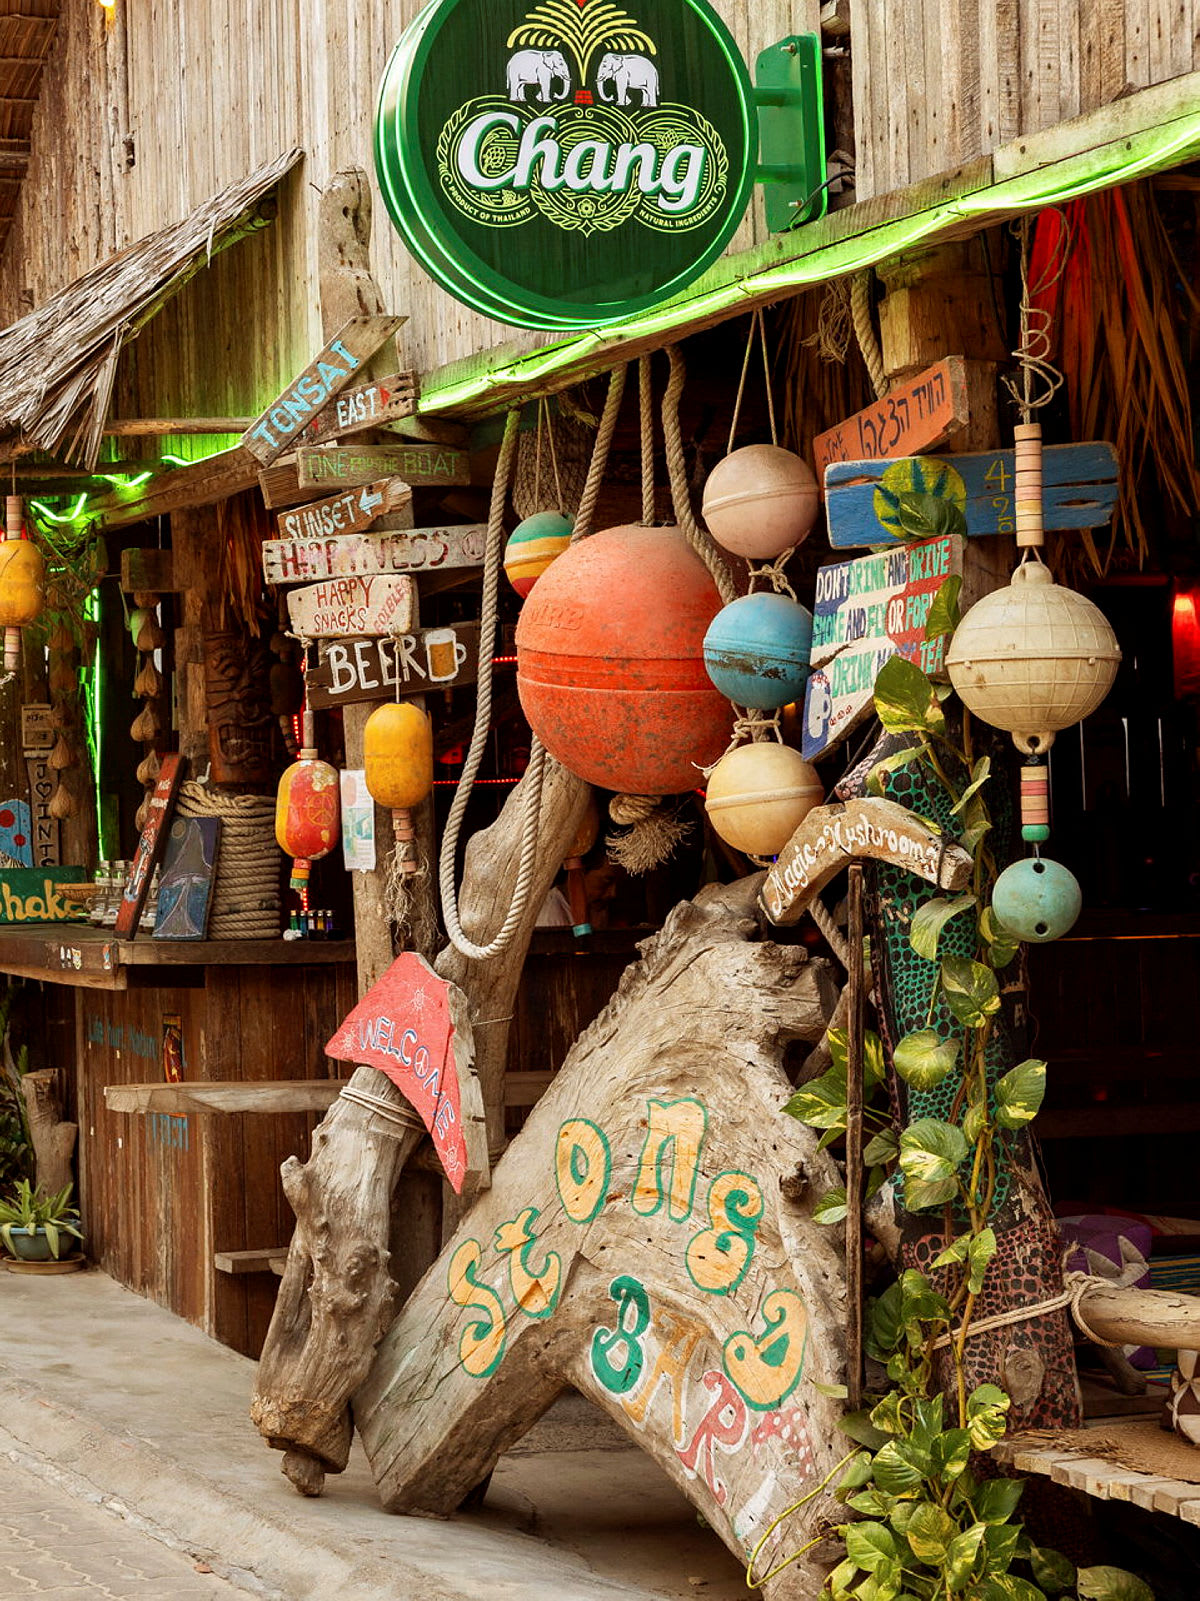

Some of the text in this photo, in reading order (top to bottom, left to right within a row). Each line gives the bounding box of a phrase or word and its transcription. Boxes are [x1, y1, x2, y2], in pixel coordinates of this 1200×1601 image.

[457, 112, 706, 212] Chang
[448, 187, 479, 217] PRODUCT
[491, 207, 531, 223] THAILAND
[638, 197, 718, 228] NATURAL INGREDIENTS
[251, 340, 360, 449] TONSAI
[336, 387, 378, 428] EAST
[307, 452, 348, 479] ONE
[402, 452, 461, 477] BOAT
[284, 495, 356, 539] SUNSET
[315, 575, 375, 609] HAPPY
[816, 539, 950, 604] DON'T DRINK AND DRIVE
[313, 607, 367, 633] SNACKS
[845, 607, 867, 641] AND
[888, 599, 905, 635] OR
[325, 634, 427, 694] BEER
[832, 650, 876, 699] DRINK
[920, 635, 944, 675] TEA
[771, 843, 818, 917] Magic
[358, 1016, 456, 1140] WELCOME
[590, 1275, 750, 1506] BAR
